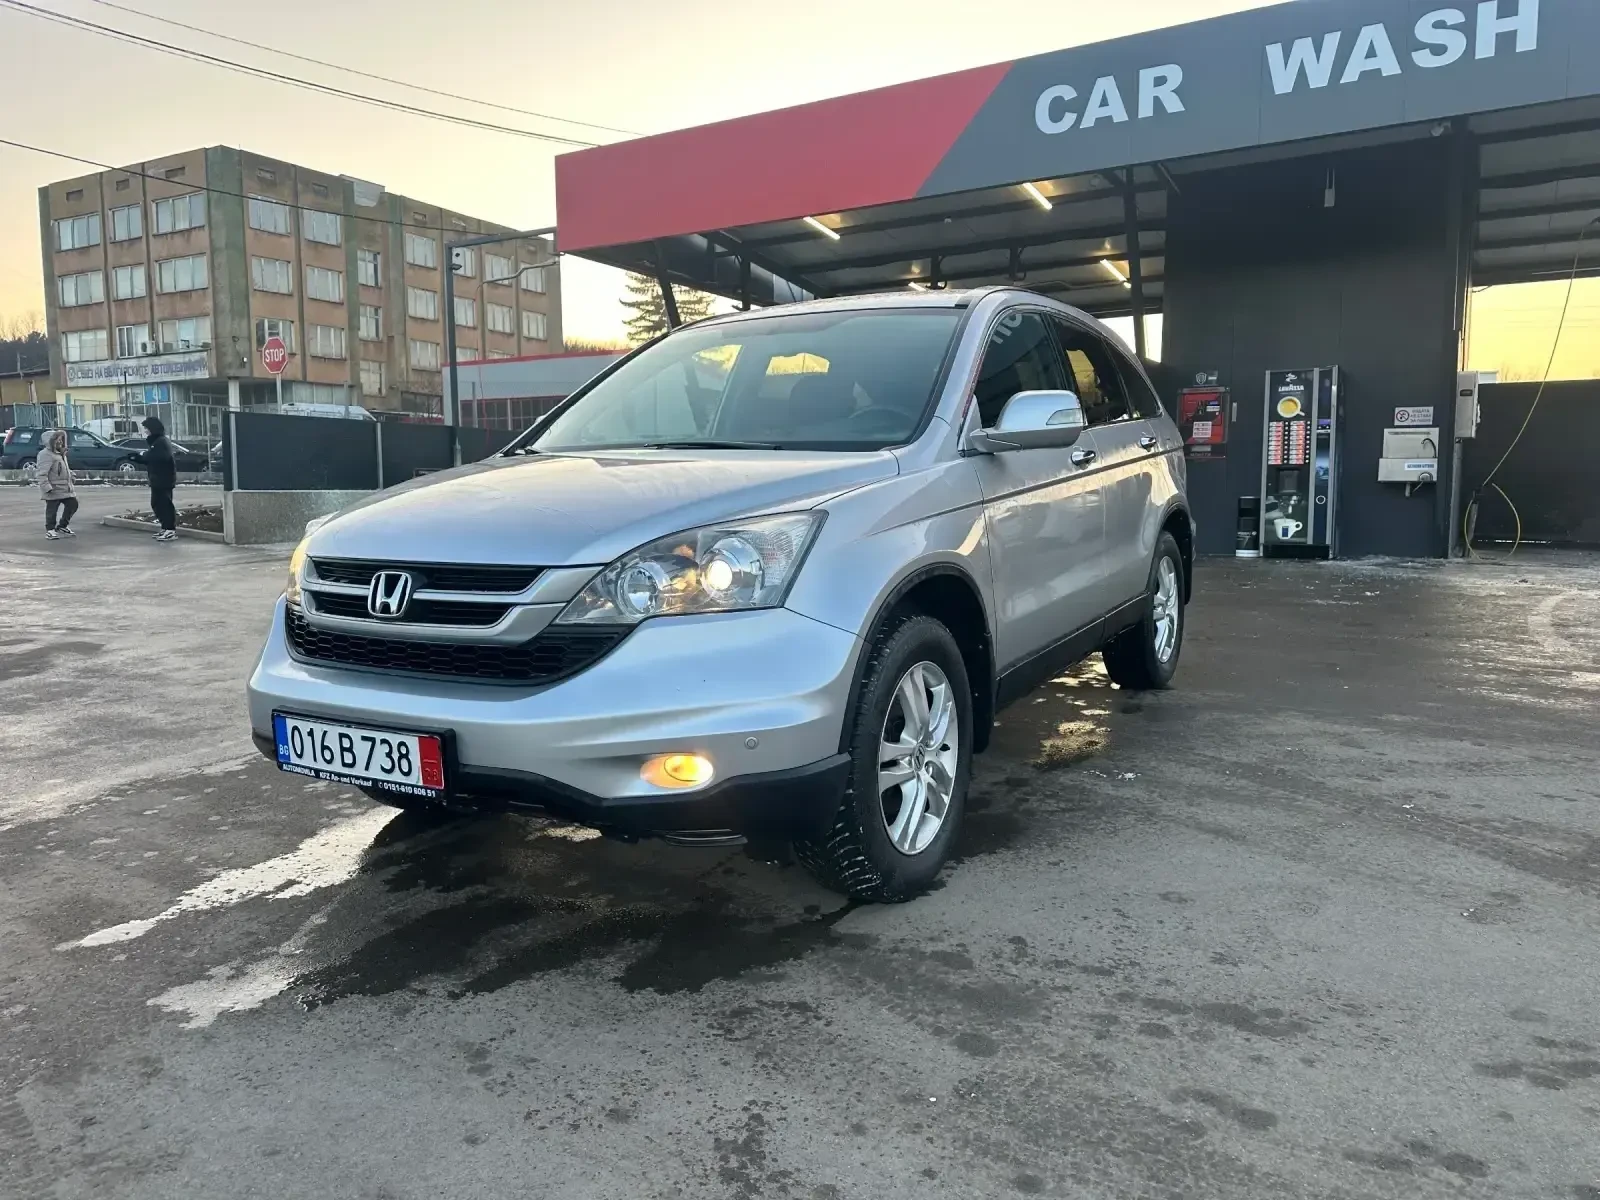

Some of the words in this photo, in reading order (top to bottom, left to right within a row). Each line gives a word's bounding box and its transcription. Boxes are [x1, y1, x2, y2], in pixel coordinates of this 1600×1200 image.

[1034, 63, 1186, 135] CAR
[1265, 0, 1540, 95] WASH
[265, 348, 285, 362] STOP
[279, 744, 289, 755] BG
[291, 725, 413, 777] 016B738
